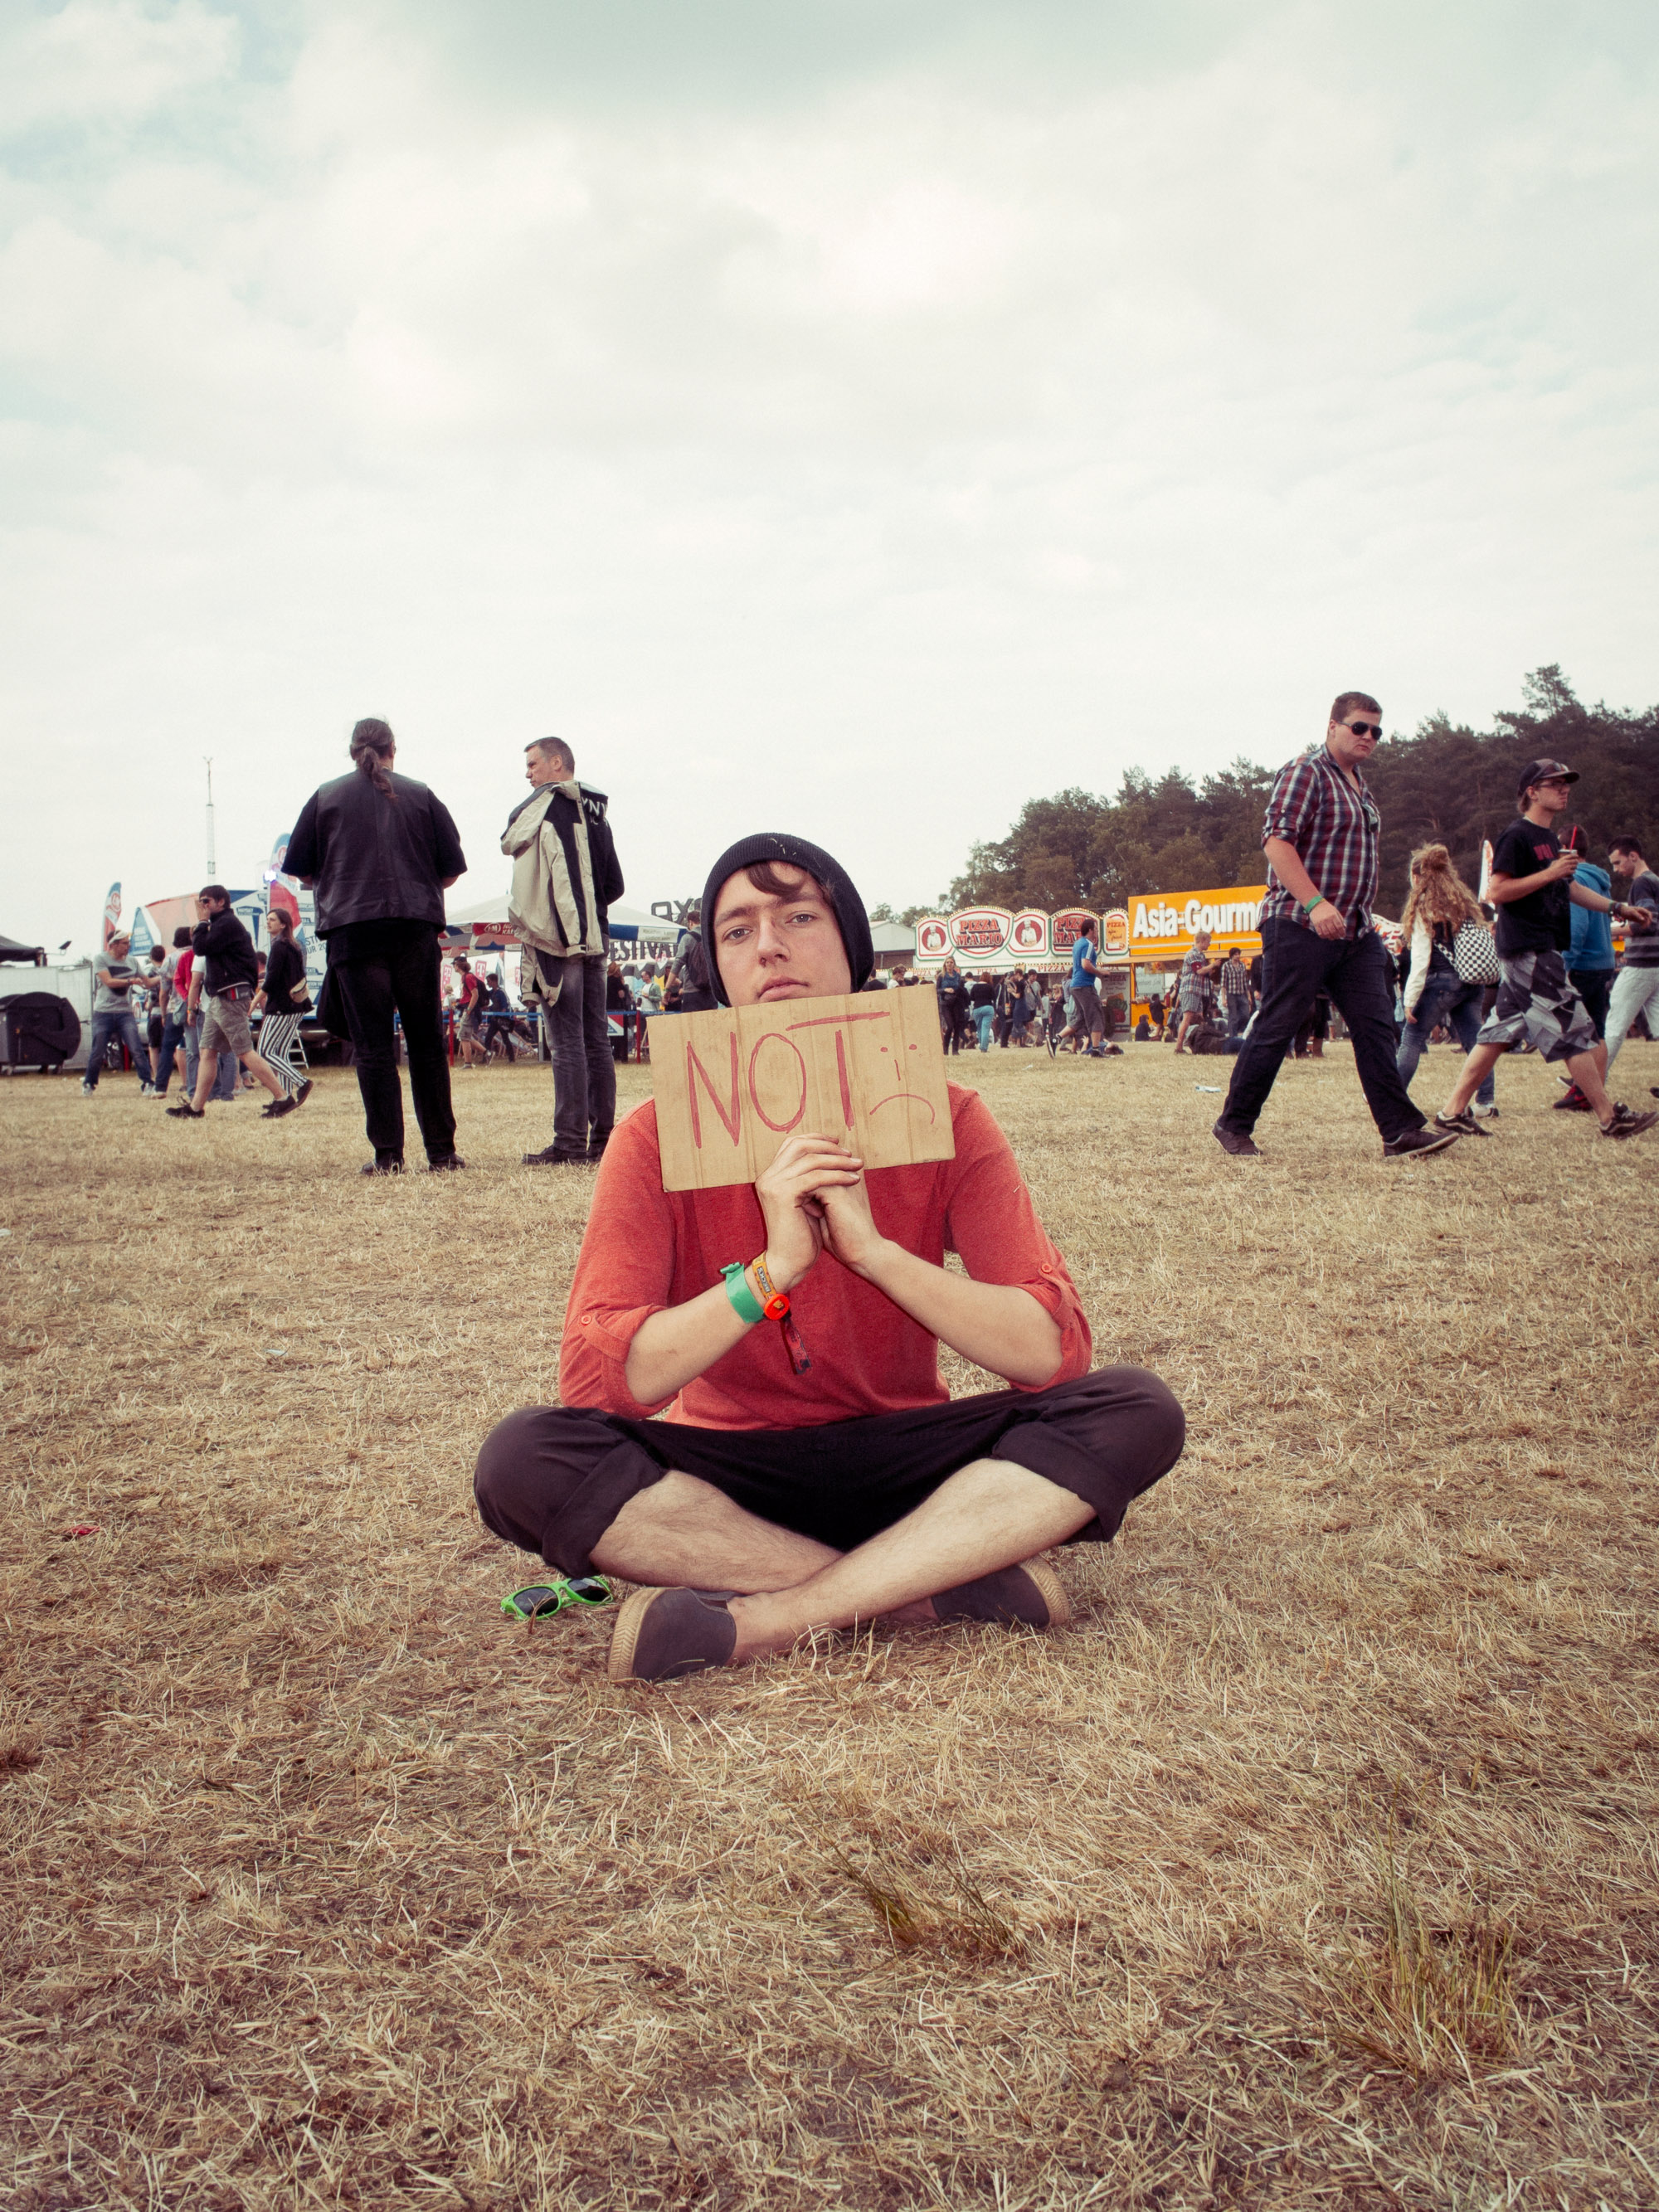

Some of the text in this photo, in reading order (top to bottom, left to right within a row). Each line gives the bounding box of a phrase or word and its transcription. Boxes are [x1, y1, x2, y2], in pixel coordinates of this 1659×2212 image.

[959, 917, 1000, 933] PIZZA
[1057, 916, 1085, 931] PIZZ
[956, 932, 1004, 947] MARIO
[686, 1010, 891, 1150] NOT
